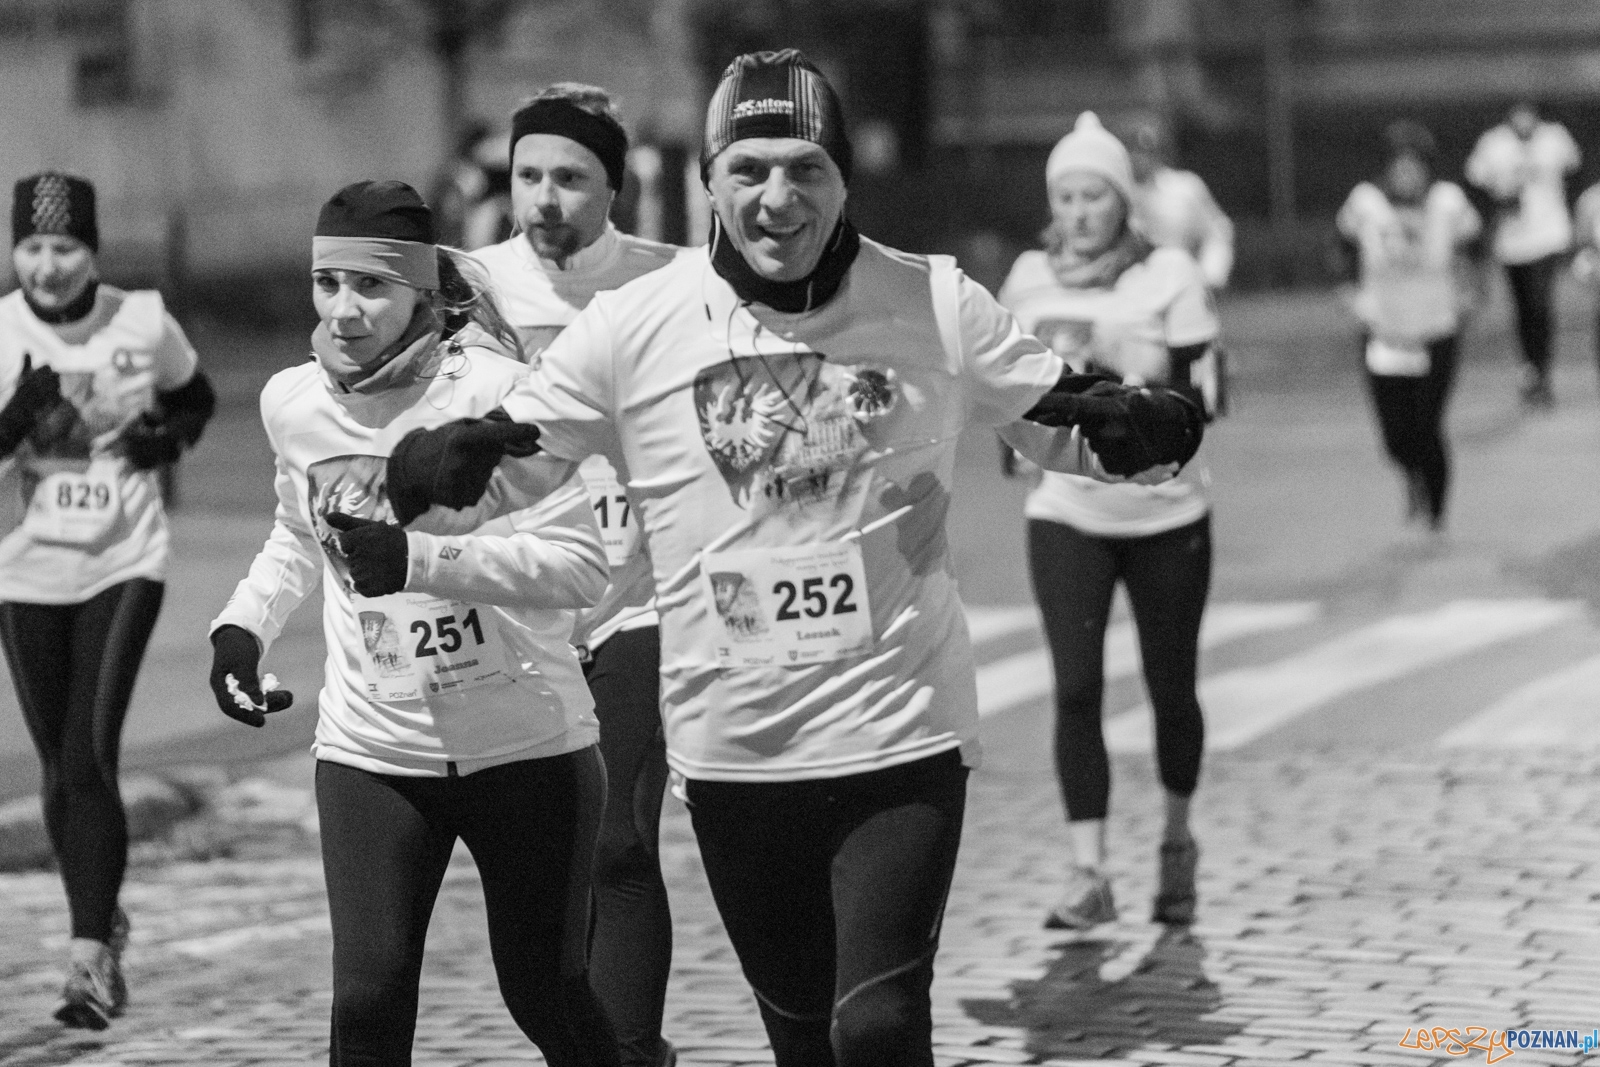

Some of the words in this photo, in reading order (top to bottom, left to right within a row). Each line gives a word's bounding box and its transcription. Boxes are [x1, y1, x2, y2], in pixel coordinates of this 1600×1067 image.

[57, 482, 110, 509] 829
[772, 573, 858, 621] 252
[410, 608, 485, 658] 251
[434, 658, 479, 675] Joanna
